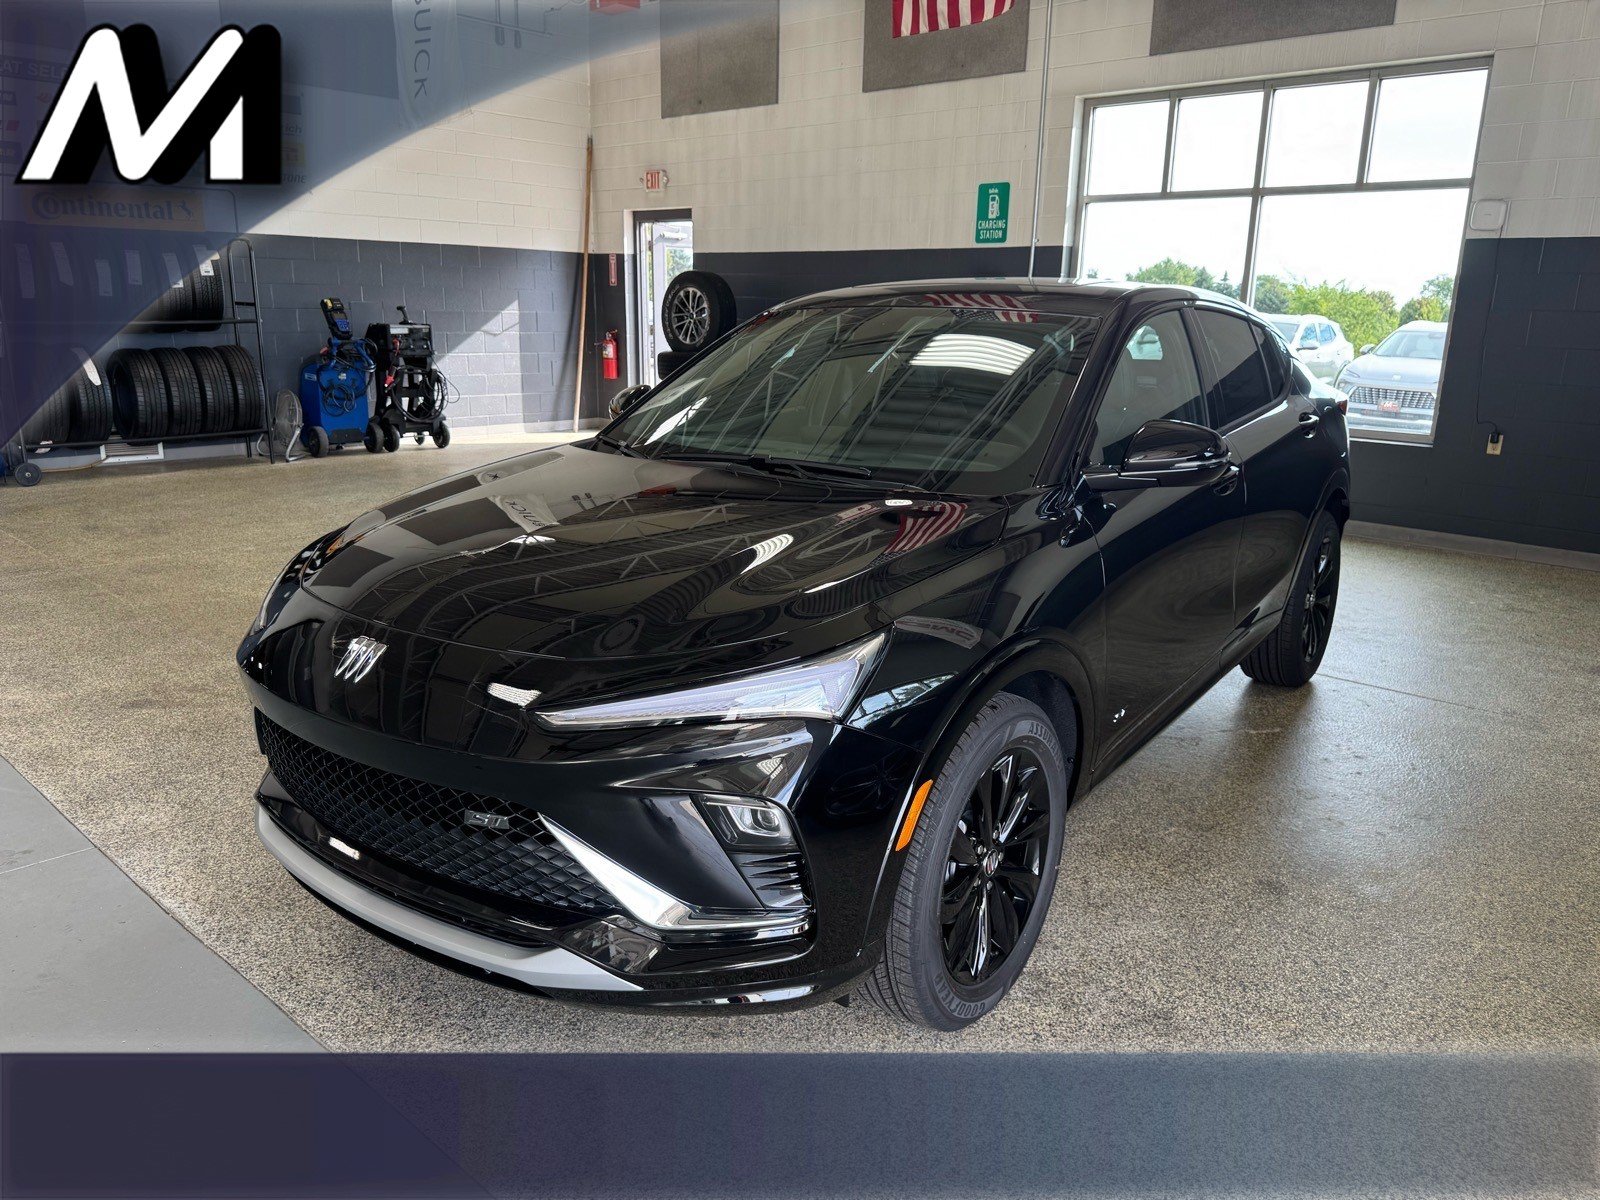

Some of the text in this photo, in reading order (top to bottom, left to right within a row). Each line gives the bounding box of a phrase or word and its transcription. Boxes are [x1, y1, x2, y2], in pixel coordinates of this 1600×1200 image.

[413, 0, 432, 99] UICK
[32, 191, 173, 221] Continental
[978, 220, 1006, 229] CHARGING
[980, 230, 1002, 239] STATION
